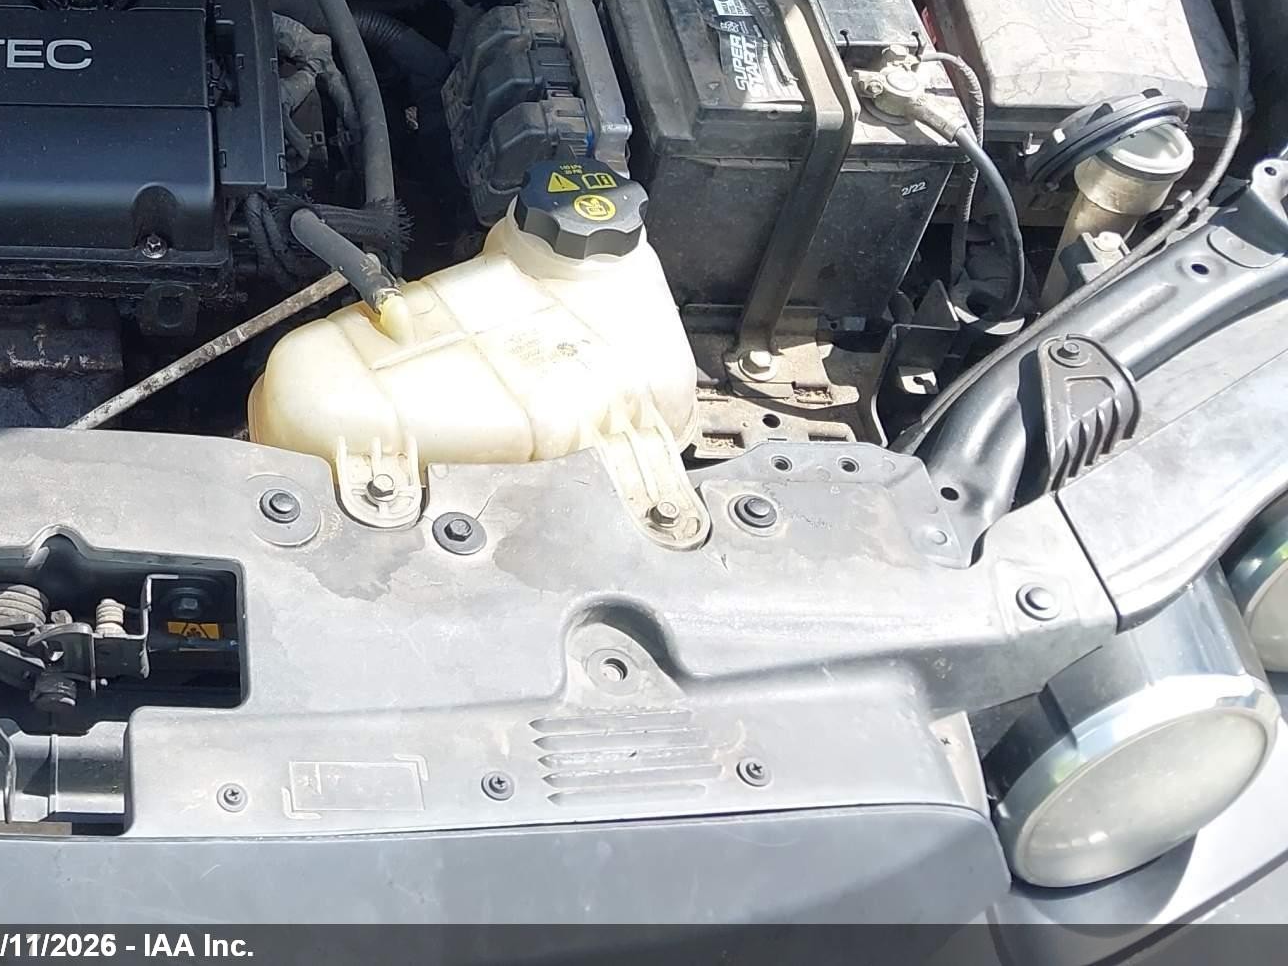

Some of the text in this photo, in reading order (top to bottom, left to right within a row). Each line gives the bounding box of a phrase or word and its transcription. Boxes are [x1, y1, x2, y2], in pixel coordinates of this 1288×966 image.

[730, 33, 749, 91] SUPER
[741, 34, 765, 93] START
[901, 181, 927, 196] 2/22
